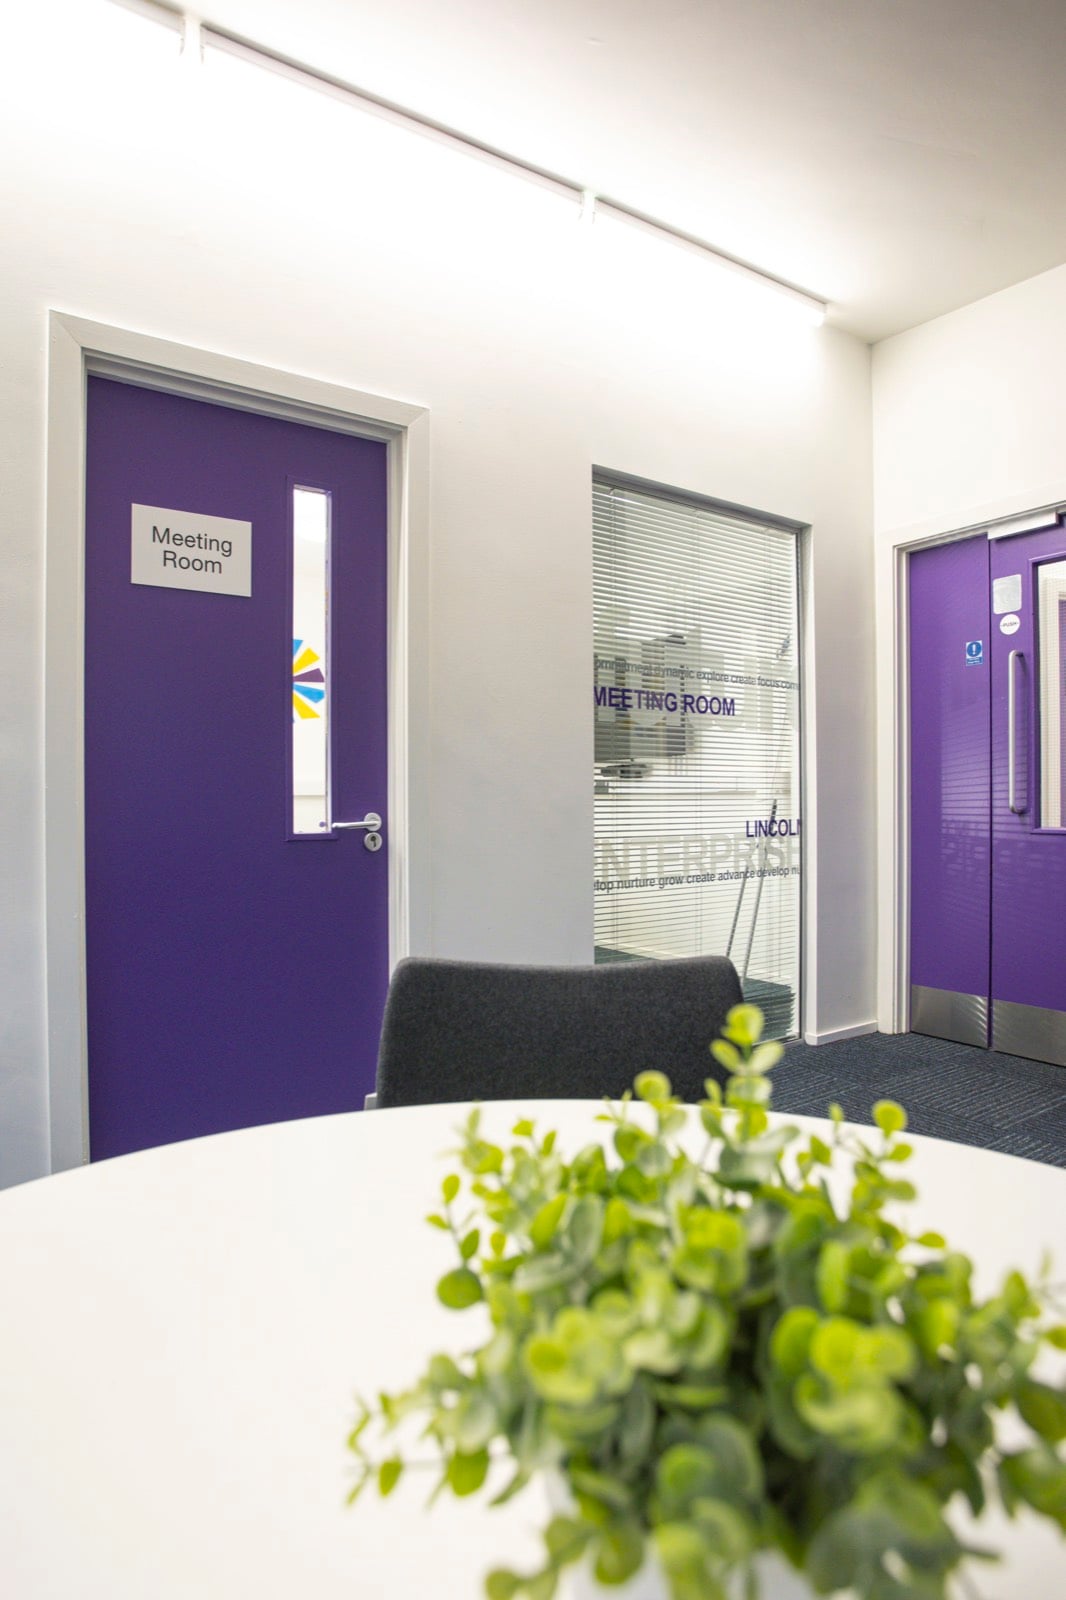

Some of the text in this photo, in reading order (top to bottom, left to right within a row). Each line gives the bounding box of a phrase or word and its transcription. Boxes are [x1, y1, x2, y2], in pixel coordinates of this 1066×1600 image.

[152, 525, 233, 558] Meeting
[163, 549, 222, 574] Room
[697, 671, 728, 684] explore
[730, 674, 757, 686] create
[757, 676, 780, 688] focus
[594, 686, 735, 716] MEETING ROOM
[616, 877, 656, 890] nurture
[658, 876, 684, 889] grow
[686, 872, 715, 885] create
[718, 869, 755, 882] advance
[757, 865, 790, 878] develop
